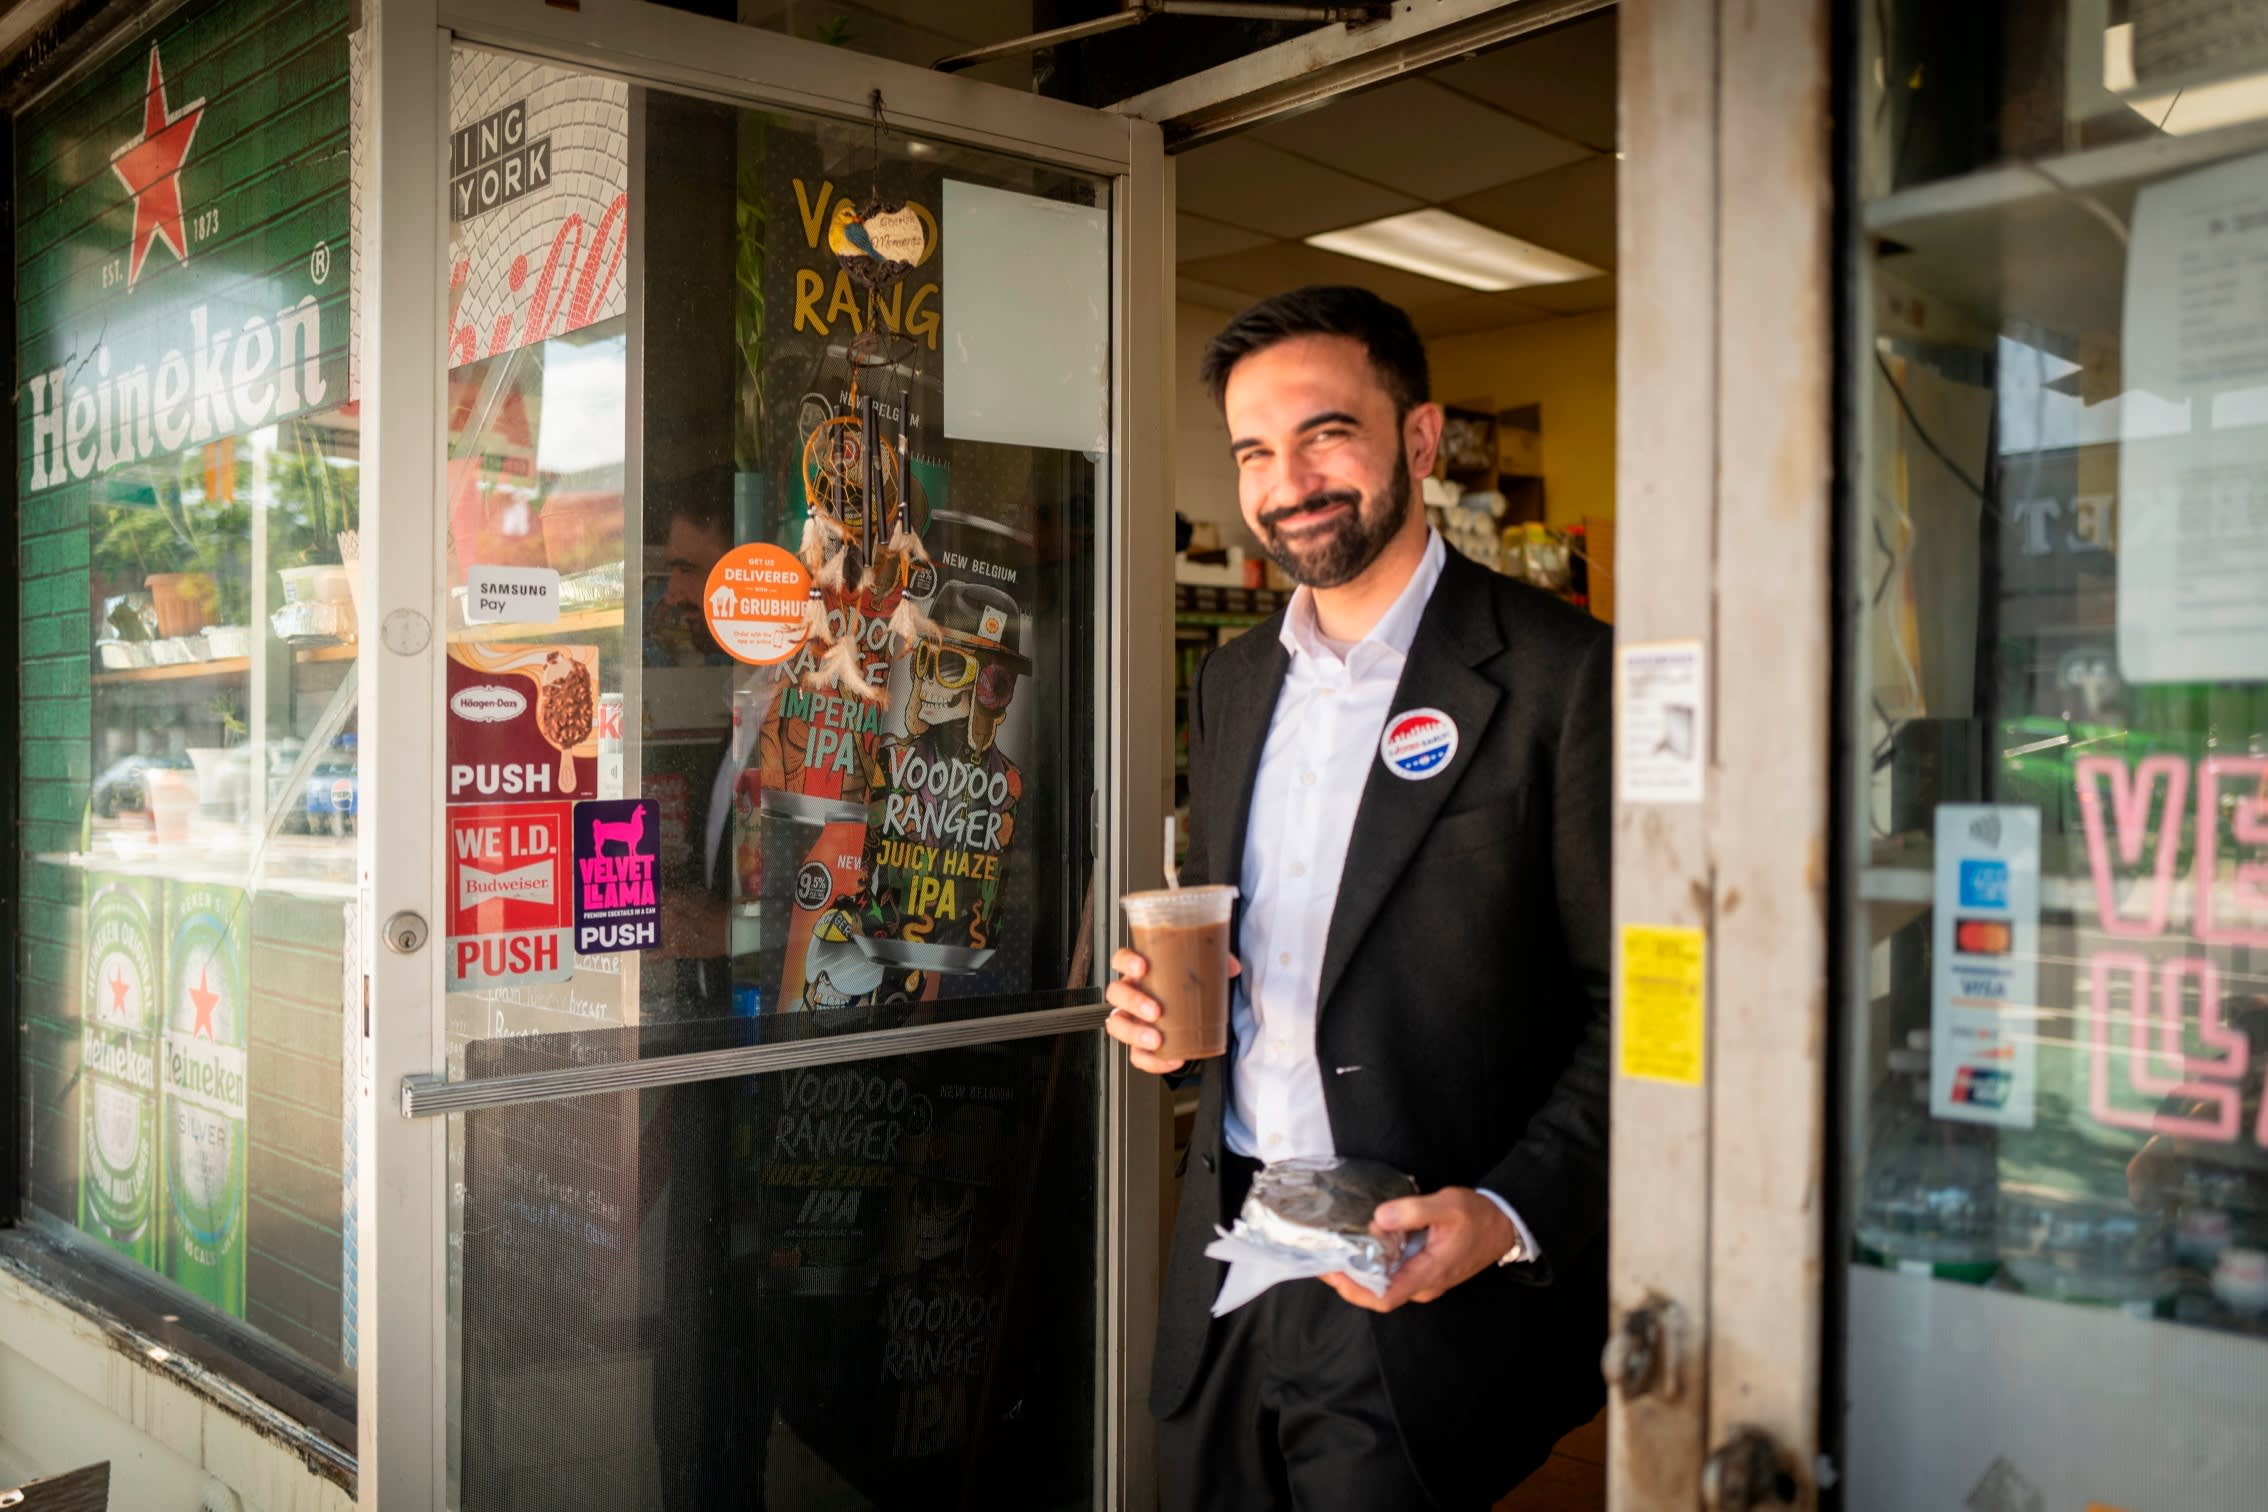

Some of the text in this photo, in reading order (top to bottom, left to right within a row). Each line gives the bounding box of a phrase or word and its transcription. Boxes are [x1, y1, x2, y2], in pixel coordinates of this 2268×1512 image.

[458, 144, 548, 216] YORK
[193, 209, 219, 243] 1873
[102, 260, 123, 289] EST.
[794, 269, 941, 350] RANG
[30, 294, 327, 492] Heineken
[872, 400, 920, 428] BELGM
[724, 568, 800, 584] DELIVERED
[748, 558, 775, 567] GET US
[942, 551, 1018, 583] NEW BELGIUM
[480, 582, 547, 597] SAMSUNG
[480, 598, 506, 613] Pay
[779, 687, 882, 736] IMPERIA
[804, 726, 856, 776] IPA
[451, 763, 550, 795] PUSH
[890, 746, 1008, 806] VOODOO
[882, 793, 1002, 851] RANGER
[455, 825, 557, 859] WE I.D.
[579, 855, 656, 885] VELVET
[876, 840, 999, 881] JUICY HAZE
[465, 877, 549, 894] Budweiser
[583, 880, 656, 910] LLAMA
[907, 875, 956, 921] IPA
[581, 922, 655, 950] PUSH
[457, 934, 558, 980] PUSH
[796, 1189, 863, 1225] IPA
[881, 1332, 992, 1383] RANGE
